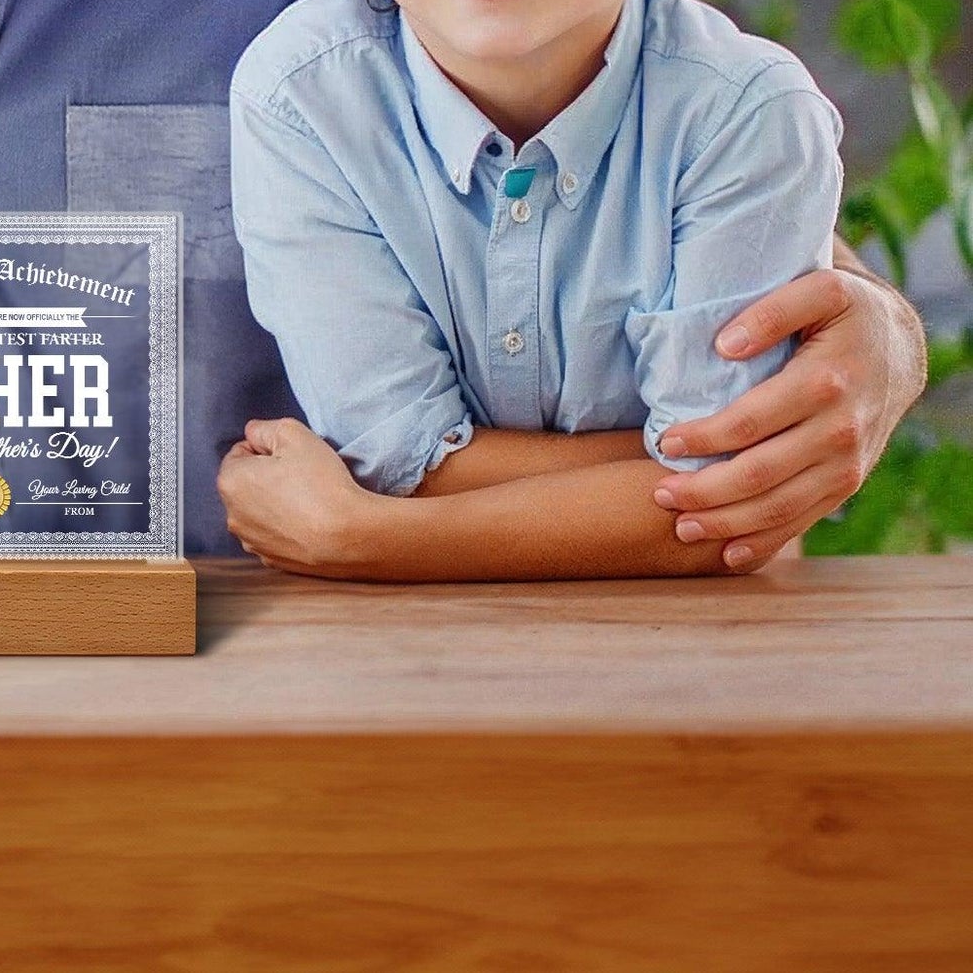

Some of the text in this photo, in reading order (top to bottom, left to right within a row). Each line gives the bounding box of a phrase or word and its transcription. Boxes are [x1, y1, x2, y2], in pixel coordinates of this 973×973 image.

[8, 313, 25, 321] NOW
[26, 313, 64, 321] OFFICIALLY
[66, 313, 80, 321] THE
[39, 332, 105, 346] FARTER
[47, 431, 120, 467] Day!
[28, 479, 132, 500] Your Loving Child
[64, 507, 95, 516] FROM
